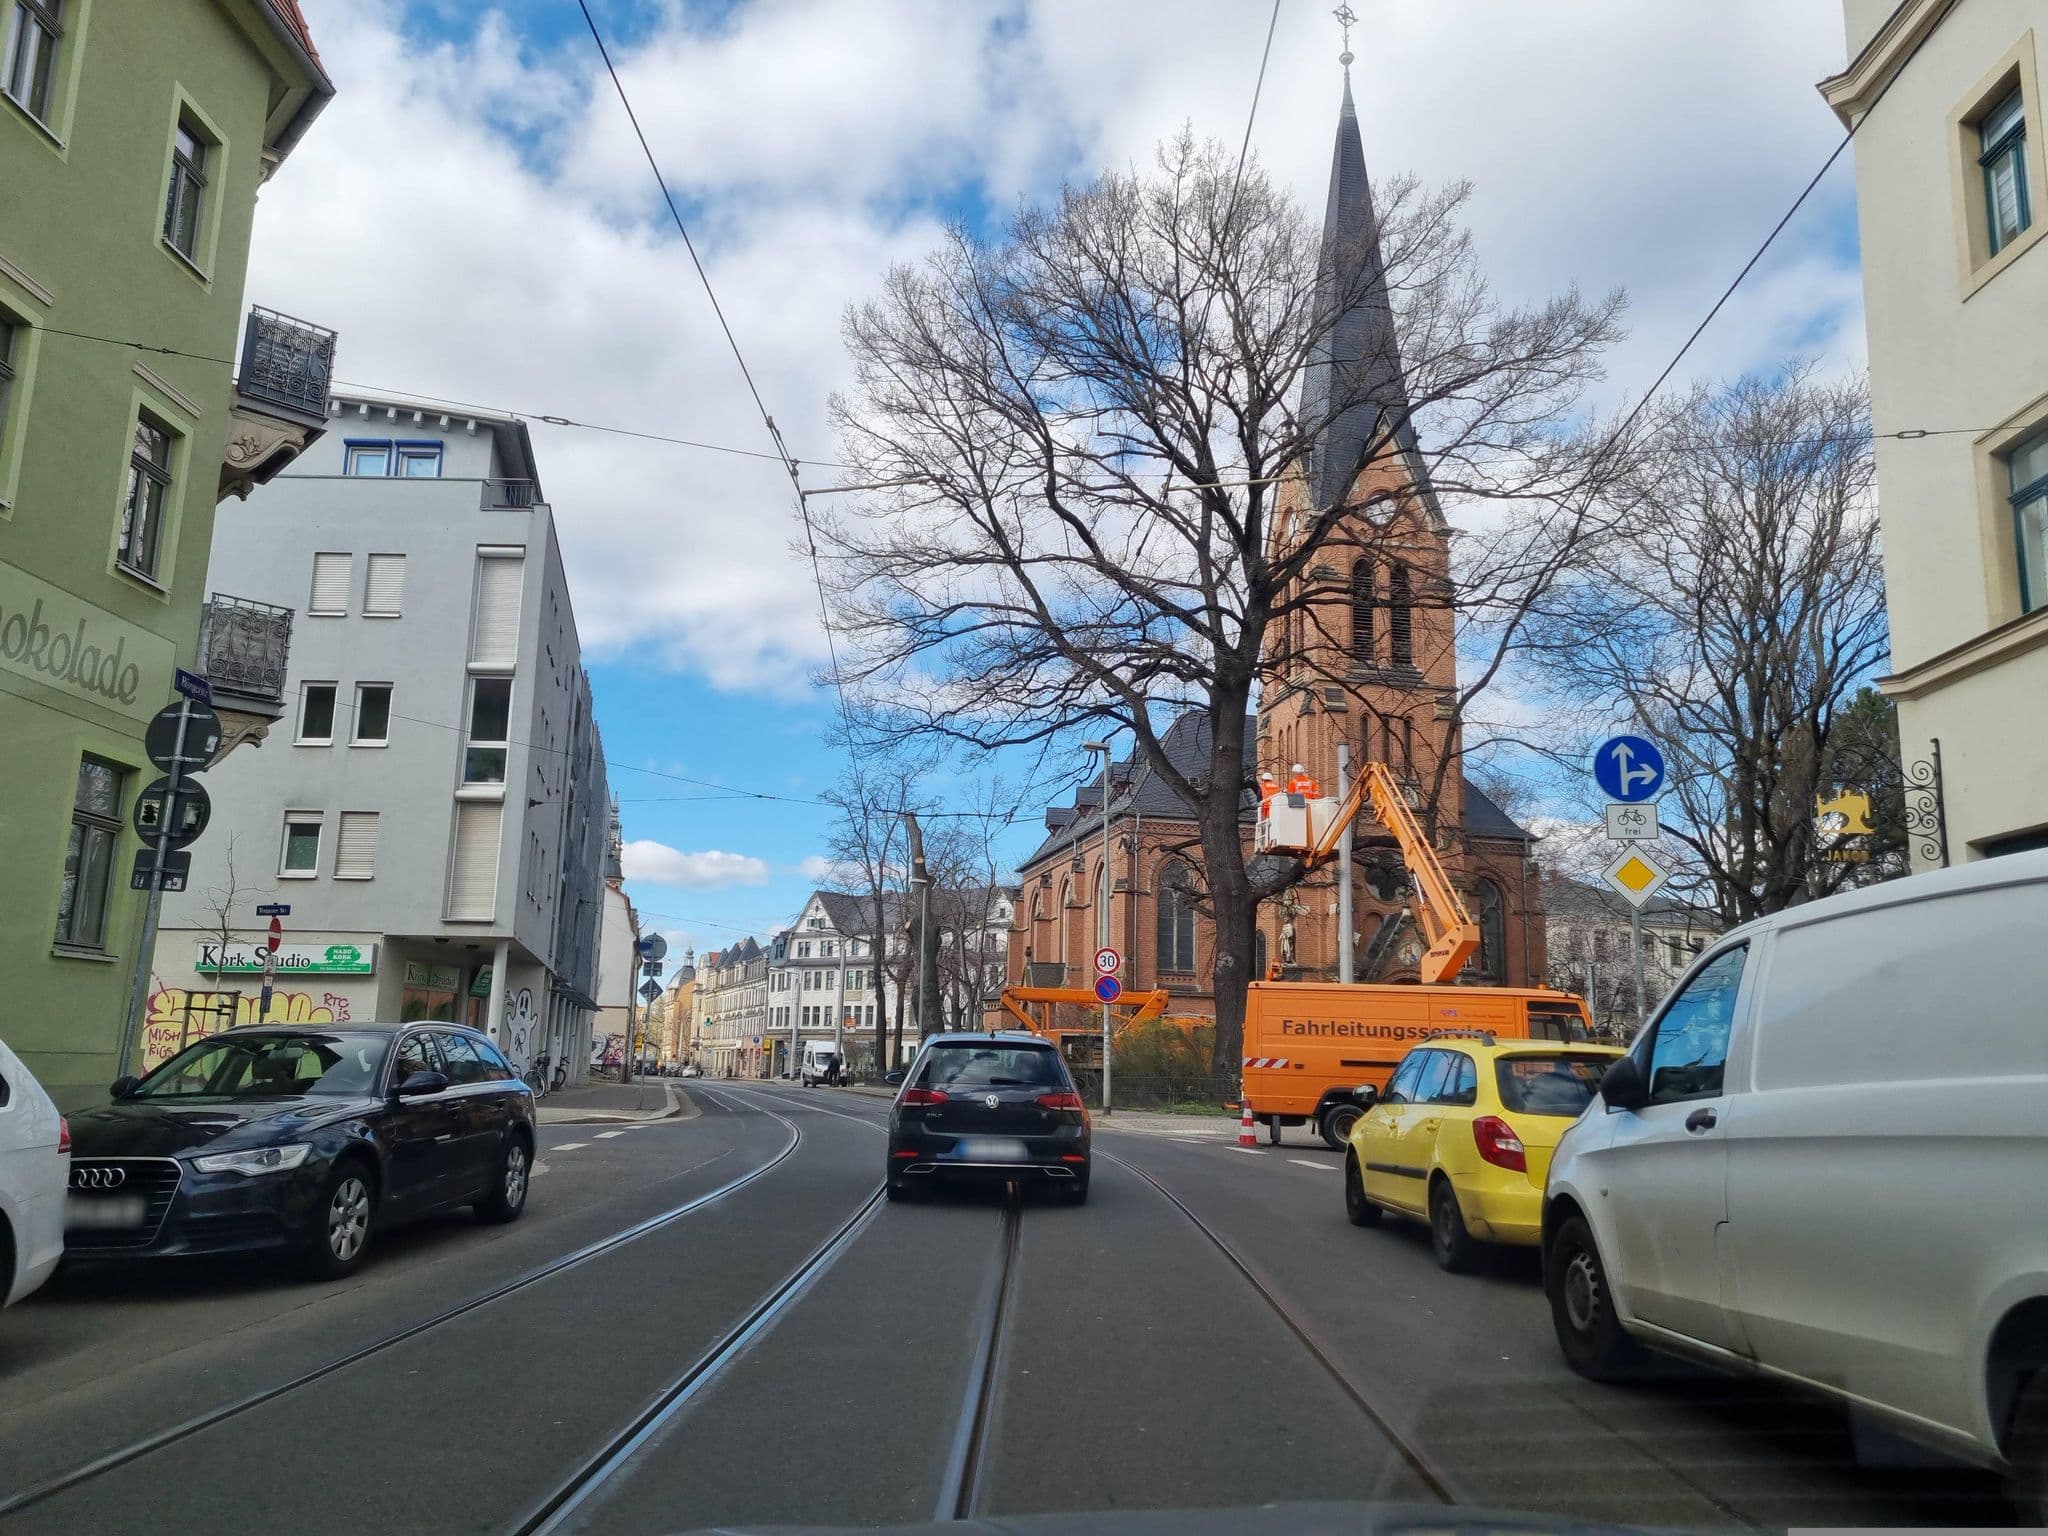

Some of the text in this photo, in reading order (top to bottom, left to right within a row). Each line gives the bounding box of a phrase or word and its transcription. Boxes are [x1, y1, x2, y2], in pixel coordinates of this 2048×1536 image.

[0, 598, 139, 705] okolade
[1624, 827, 1642, 836] frei
[201, 945, 311, 968] Kork Sudio
[1100, 955, 1115, 968] 30
[323, 992, 349, 1008] RTC
